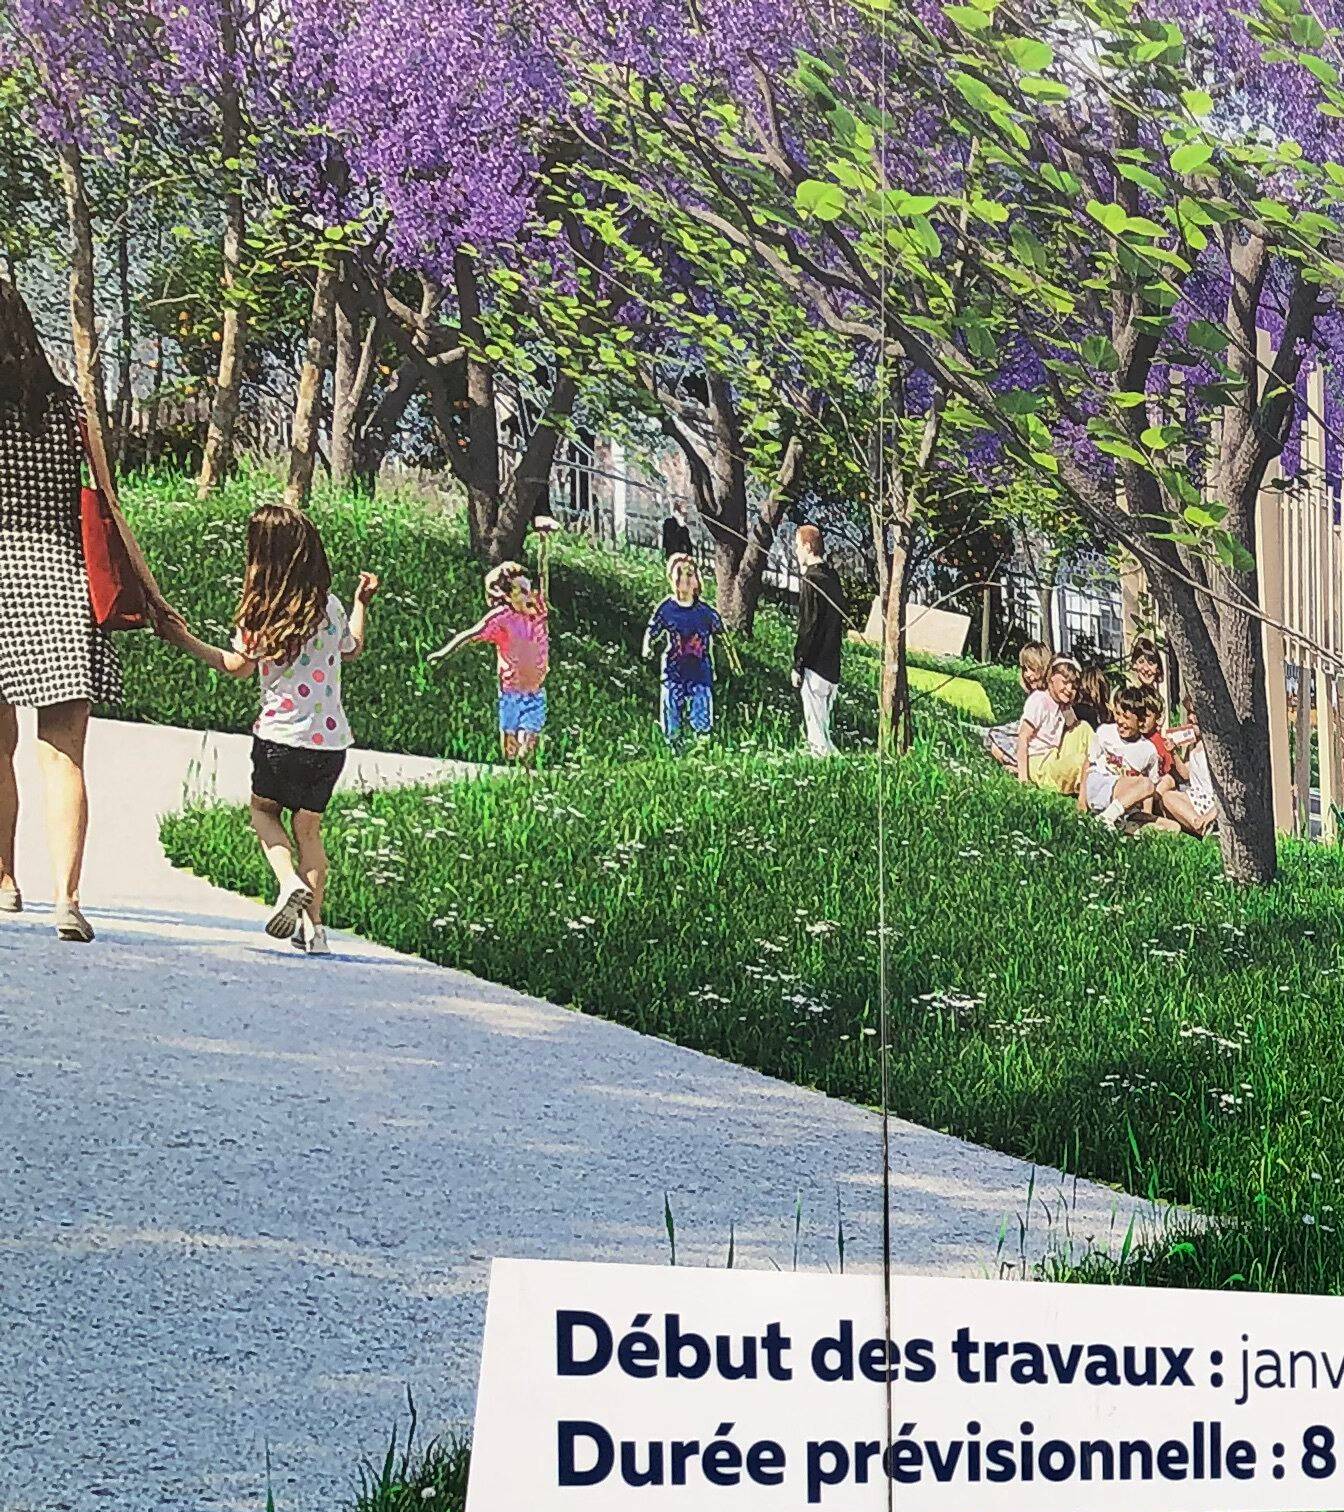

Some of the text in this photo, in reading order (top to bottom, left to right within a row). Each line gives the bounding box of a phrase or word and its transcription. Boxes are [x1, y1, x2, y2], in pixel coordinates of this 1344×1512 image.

[556, 1309, 793, 1382] Début
[810, 1319, 937, 1383] des
[557, 1420, 786, 1488] Durée
[1301, 1424, 1337, 1480] 8
